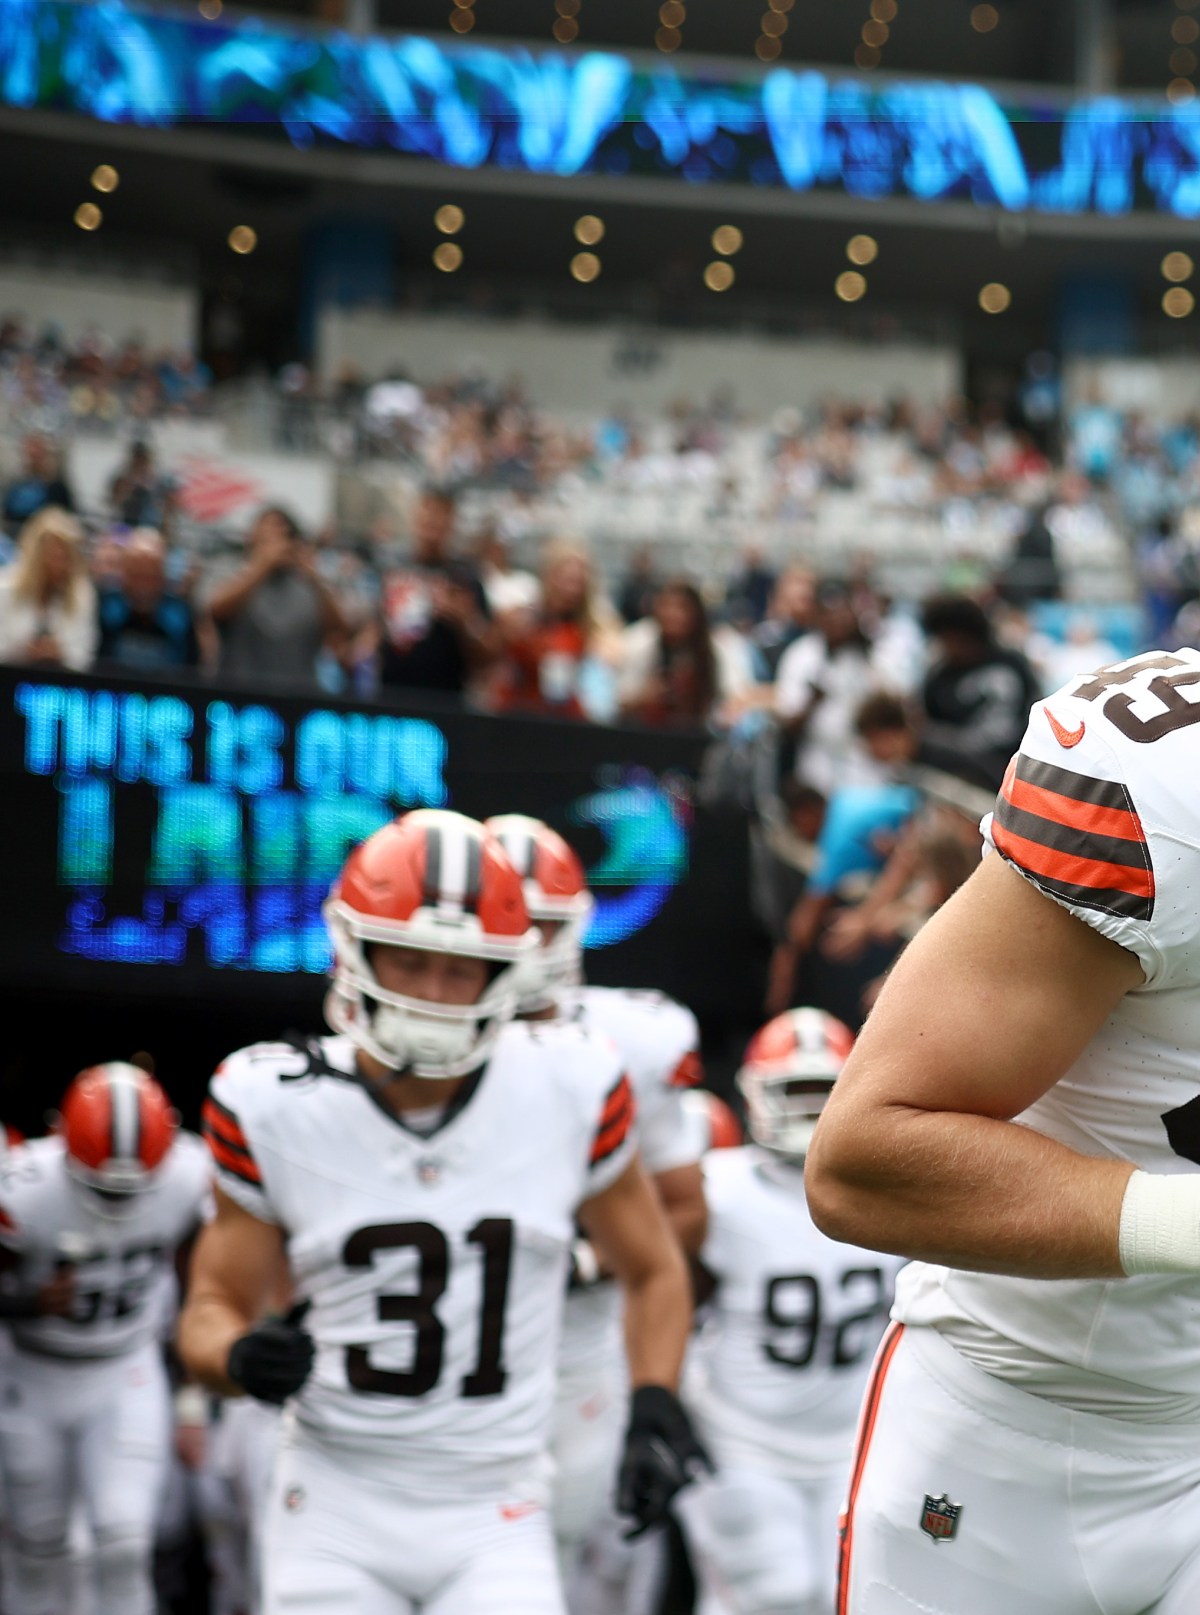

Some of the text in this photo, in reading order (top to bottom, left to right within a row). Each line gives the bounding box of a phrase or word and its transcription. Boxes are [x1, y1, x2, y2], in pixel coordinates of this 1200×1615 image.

[14, 683, 448, 808] THIS IS OUR
[343, 1218, 514, 1398] 31
[762, 1267, 884, 1368] 92
